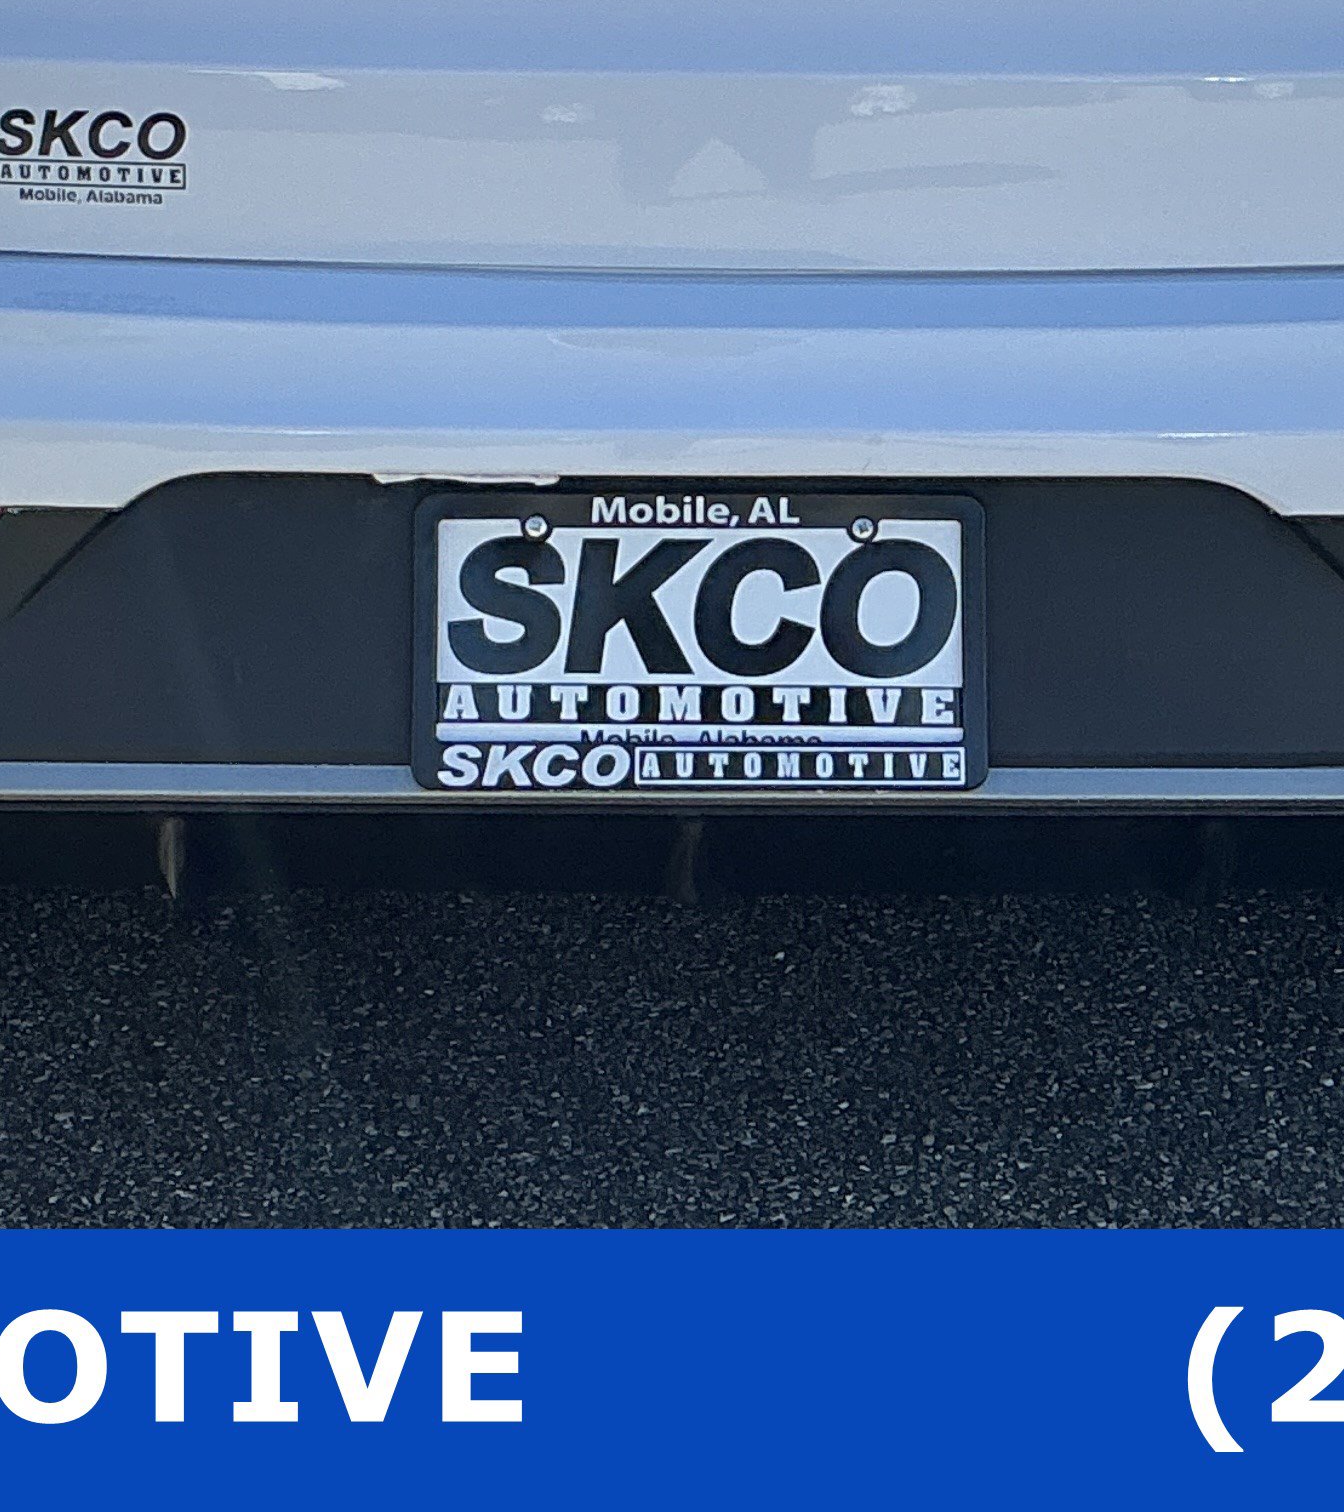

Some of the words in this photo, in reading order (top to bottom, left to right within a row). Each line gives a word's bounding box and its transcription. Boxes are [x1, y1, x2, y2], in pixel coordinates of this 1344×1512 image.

[0, 163, 182, 185] AUTOMOTIVE
[19, 188, 82, 204] Mobile,
[86, 188, 164, 205] Alabama
[591, 496, 740, 527] Mobile,
[747, 496, 801, 525] AL
[447, 535, 958, 678] SKCO
[443, 686, 955, 725] AUTOMOTIVE
[437, 744, 630, 787] SKCO
[642, 752, 961, 779] AUTOMOTIVE
